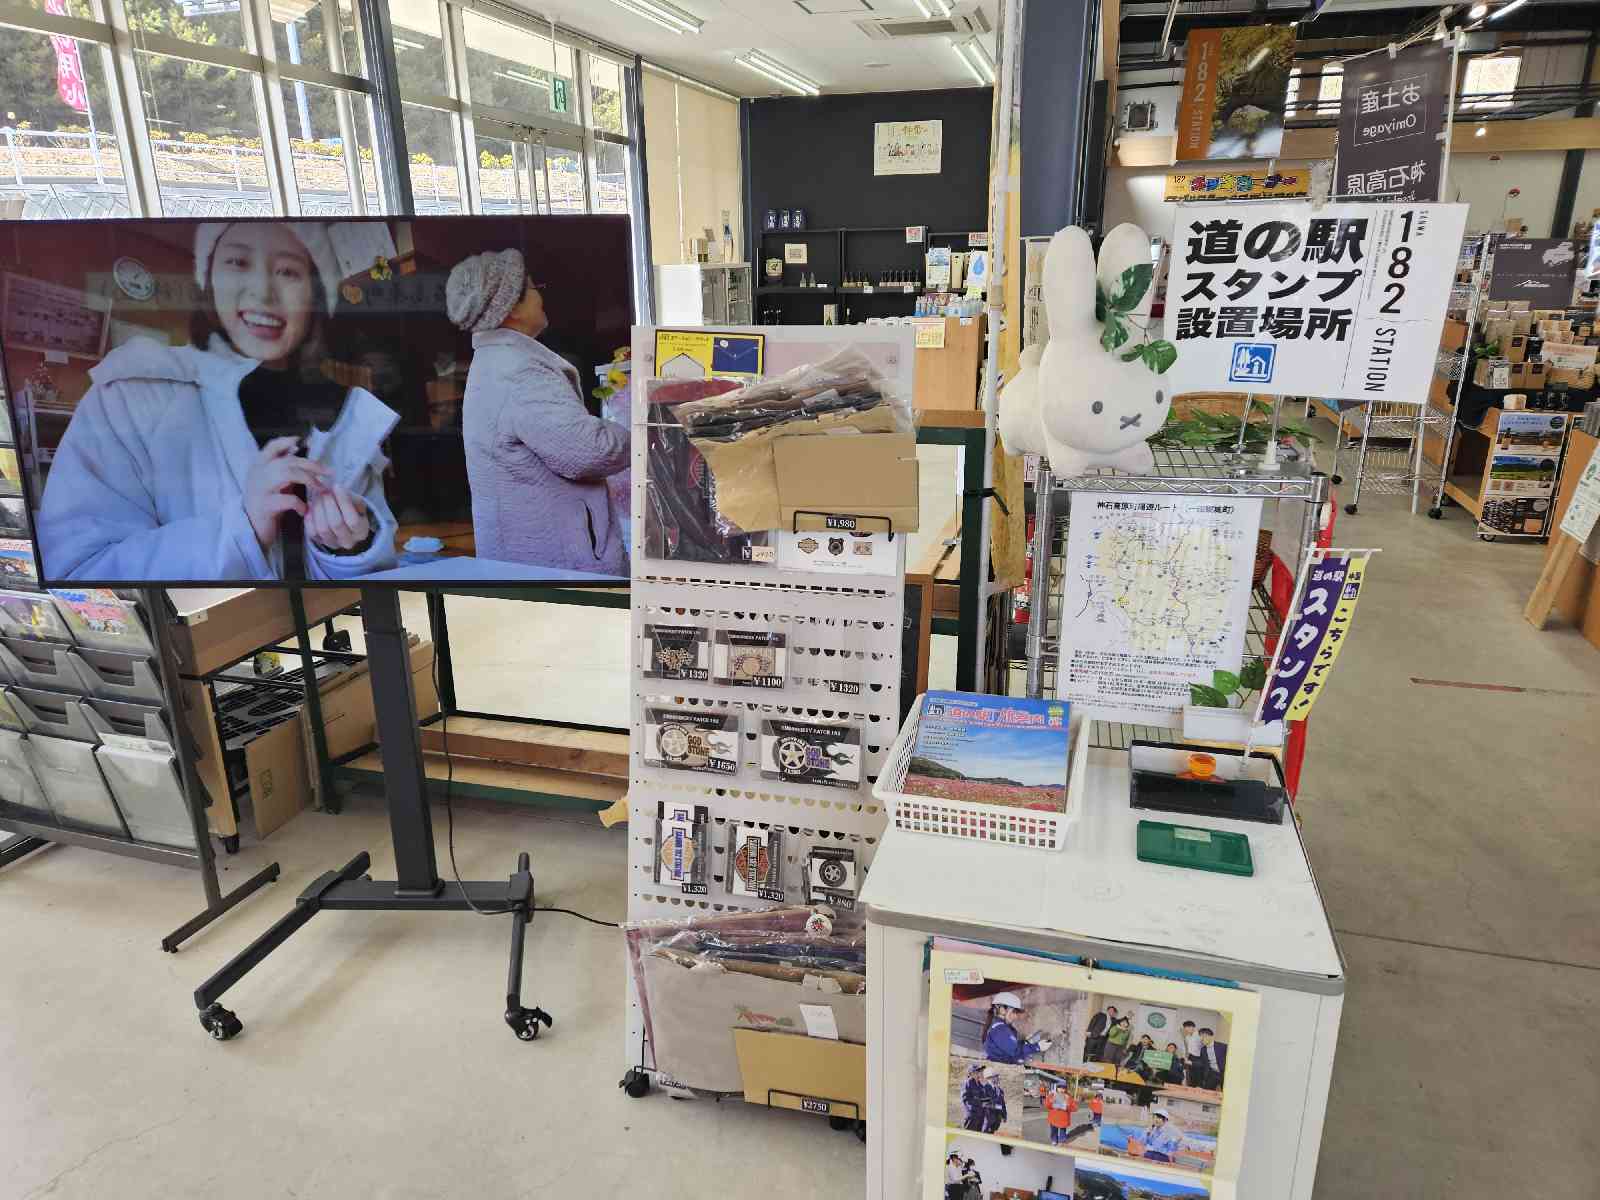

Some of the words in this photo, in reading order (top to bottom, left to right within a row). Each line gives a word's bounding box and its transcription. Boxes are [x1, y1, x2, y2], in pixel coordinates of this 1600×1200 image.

[1185, 218, 1369, 265] 道の駅
[1379, 210, 1414, 314] 182
[1181, 268, 1363, 302] スタンプ
[1176, 306, 1353, 342] 設置場所
[1363, 327, 1397, 392] STATION
[827, 517, 856, 529] ¥1,980
[1311, 569, 1345, 582] 道の駅
[1269, 587, 1329, 711] スタンプ
